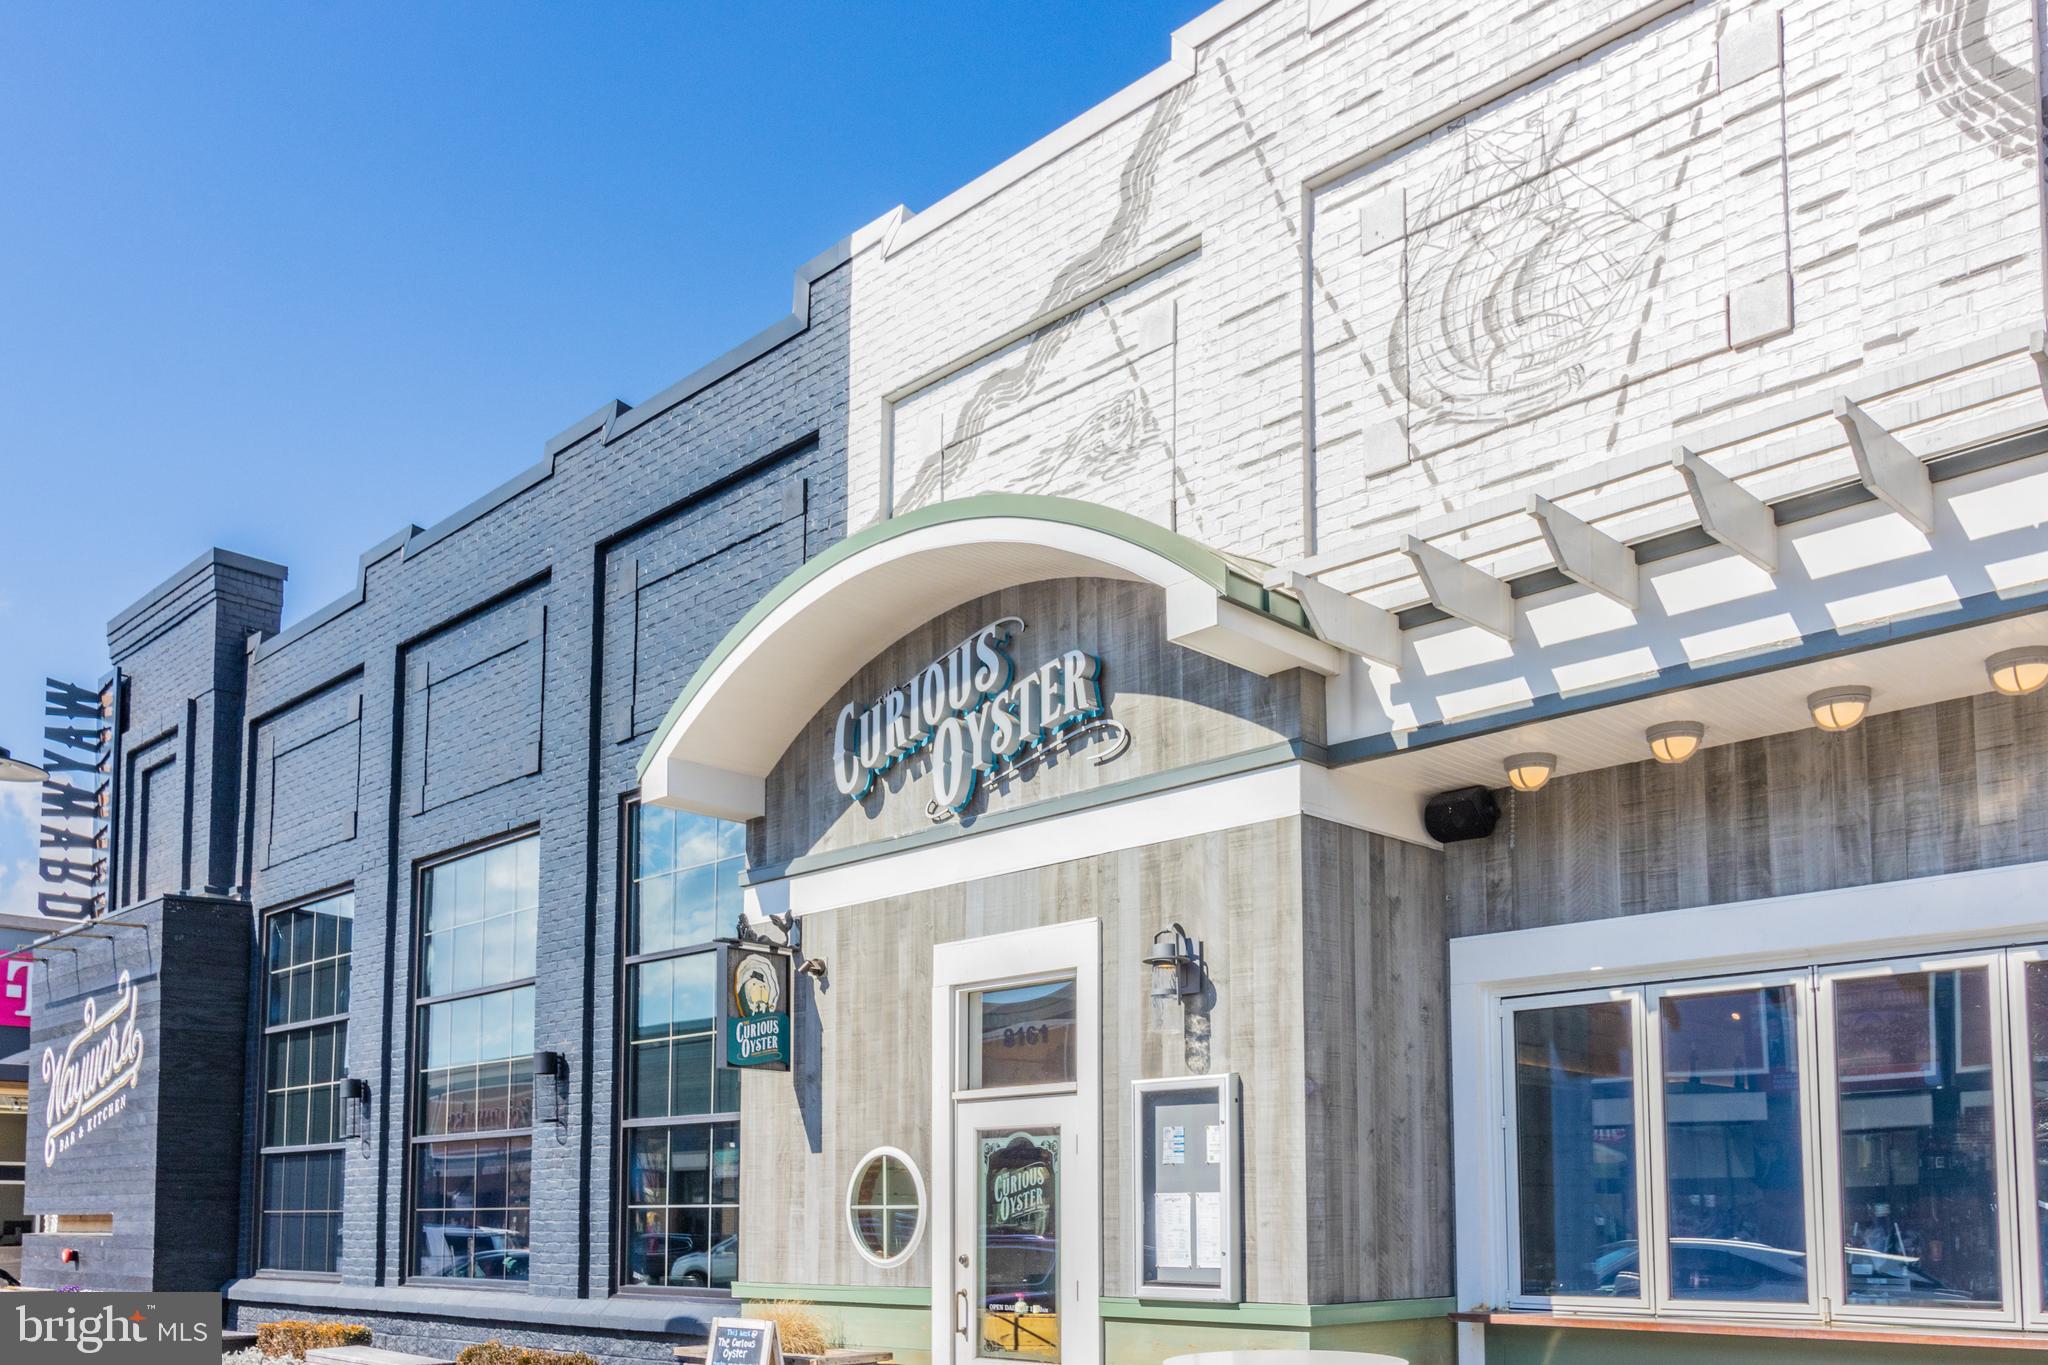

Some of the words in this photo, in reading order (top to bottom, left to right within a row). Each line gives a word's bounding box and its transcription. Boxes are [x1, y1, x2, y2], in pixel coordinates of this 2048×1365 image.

[834, 623, 1009, 798] CURIOUS
[933, 649, 1101, 809] OYSTER
[736, 1020, 779, 1043] CURIOUS
[741, 1035, 778, 1058] OYSTER
[42, 975, 144, 1150] Wayward
[59, 1131, 75, 1152] BAR
[79, 1126, 84, 1139] &
[87, 1094, 126, 1132] KITCHEN
[994, 1167, 1045, 1202] CURIOUS
[1000, 1188, 1043, 1221] OYSTER
